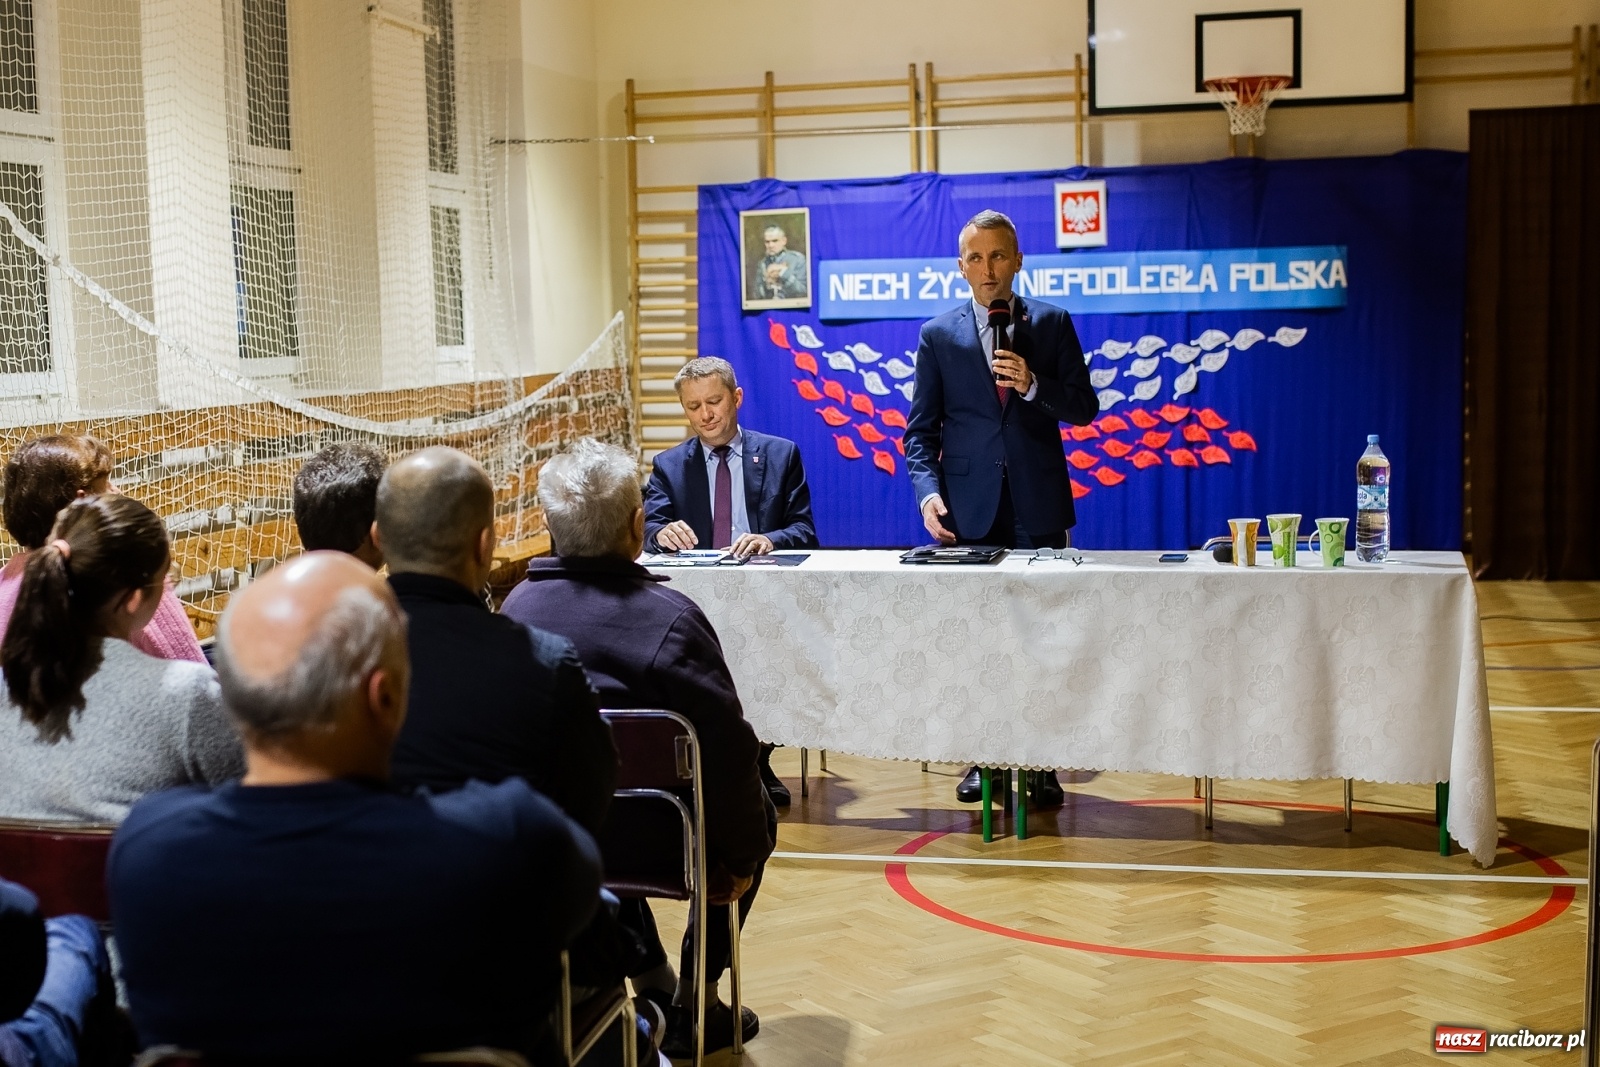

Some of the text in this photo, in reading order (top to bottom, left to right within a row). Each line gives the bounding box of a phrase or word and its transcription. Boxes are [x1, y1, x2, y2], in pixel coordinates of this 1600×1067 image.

[829, 259, 1348, 301] NIECH ŻYJ NIEPODLEGŁA POLSKA
